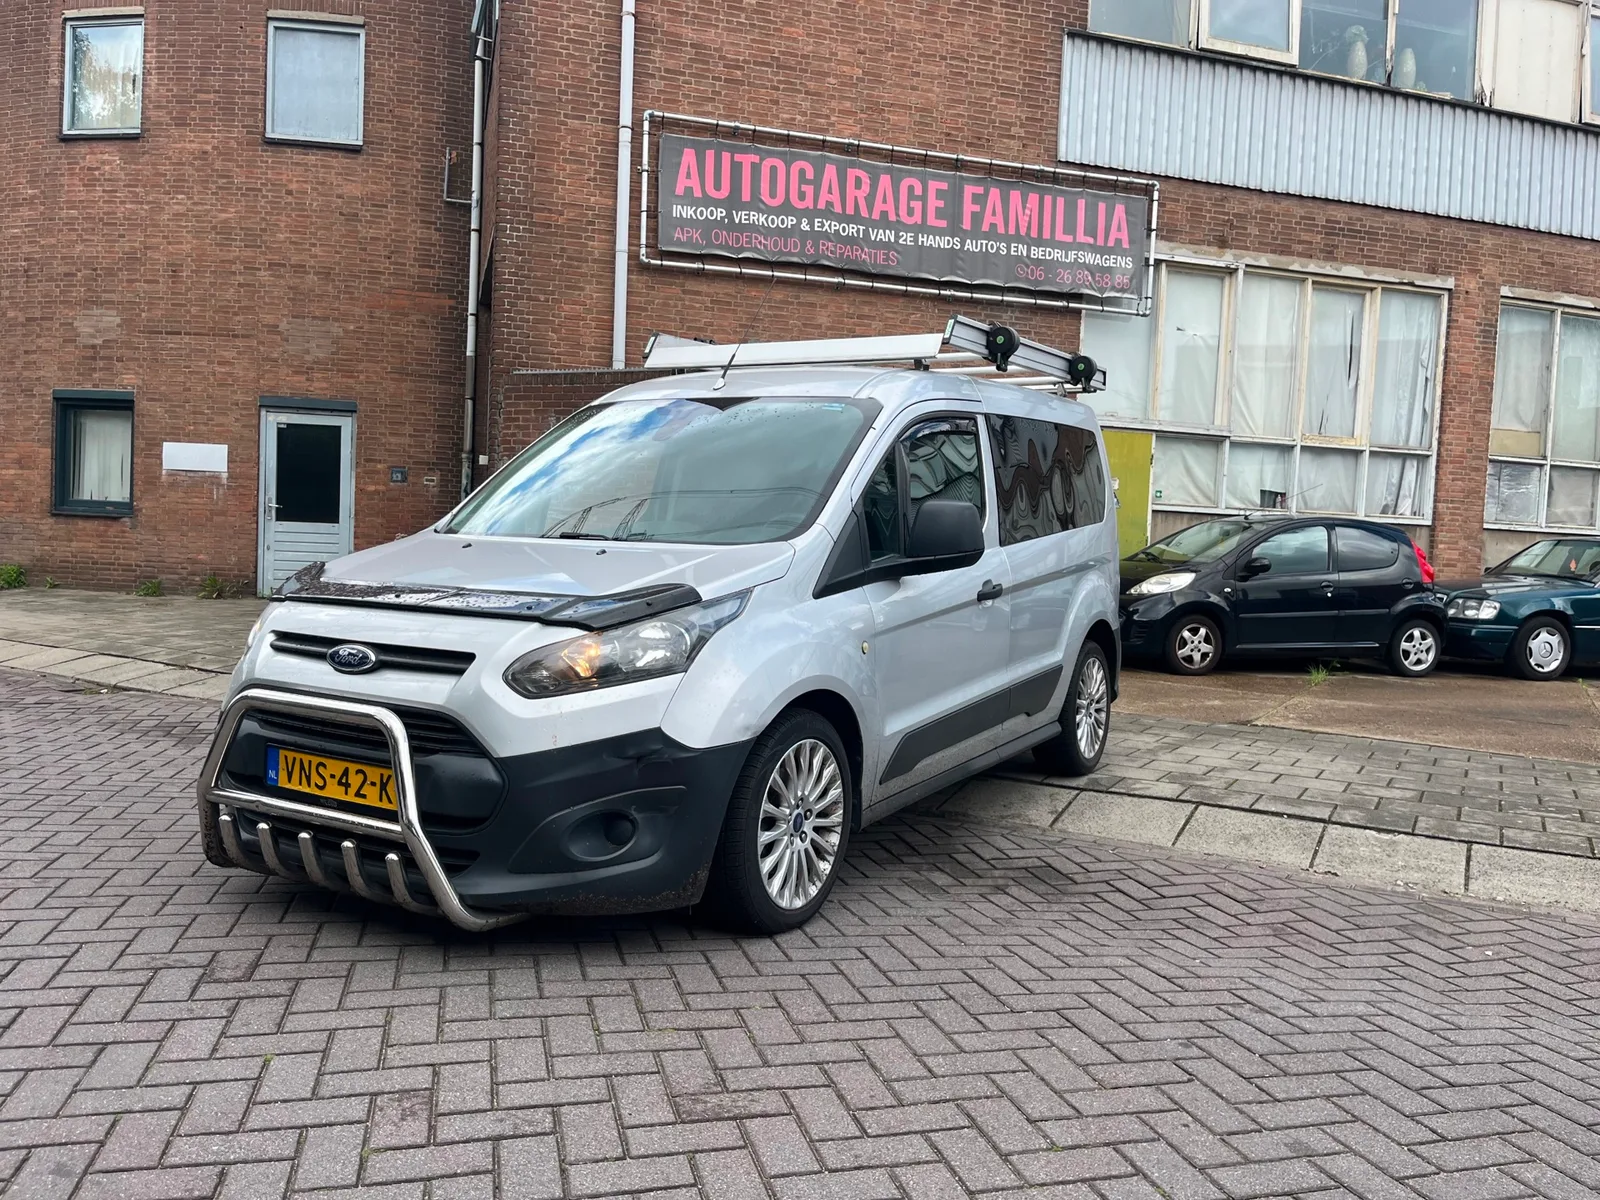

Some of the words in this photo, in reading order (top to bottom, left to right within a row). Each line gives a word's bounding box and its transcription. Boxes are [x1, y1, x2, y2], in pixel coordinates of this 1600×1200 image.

[675, 148, 949, 228] AUTOGARAGE
[962, 184, 1130, 249] FAMILLIA
[672, 204, 728, 224] INKOOP,
[732, 210, 797, 229] VERKOOP
[800, 218, 811, 231] &
[814, 218, 866, 239] EXPORT
[869, 227, 895, 243] VAN
[898, 231, 915, 246] 2E
[918, 233, 961, 250] HANDS
[964, 239, 1007, 255] AUTO'S
[1010, 243, 1027, 257] EN
[1030, 246, 1133, 269] BEDRIJFSWAGENS
[673, 227, 706, 246] APK,
[711, 229, 800, 253] ONDERHOUD
[805, 239, 815, 255] &
[819, 240, 898, 266] REPARATIES
[1028, 265, 1045, 281] 06
[1056, 268, 1072, 284] 26
[1095, 273, 1111, 288] 58
[1114, 274, 1130, 289] 85
[334, 647, 363, 665] Ford
[268, 769, 278, 780] NL
[283, 754, 394, 804] VNS-42-K
